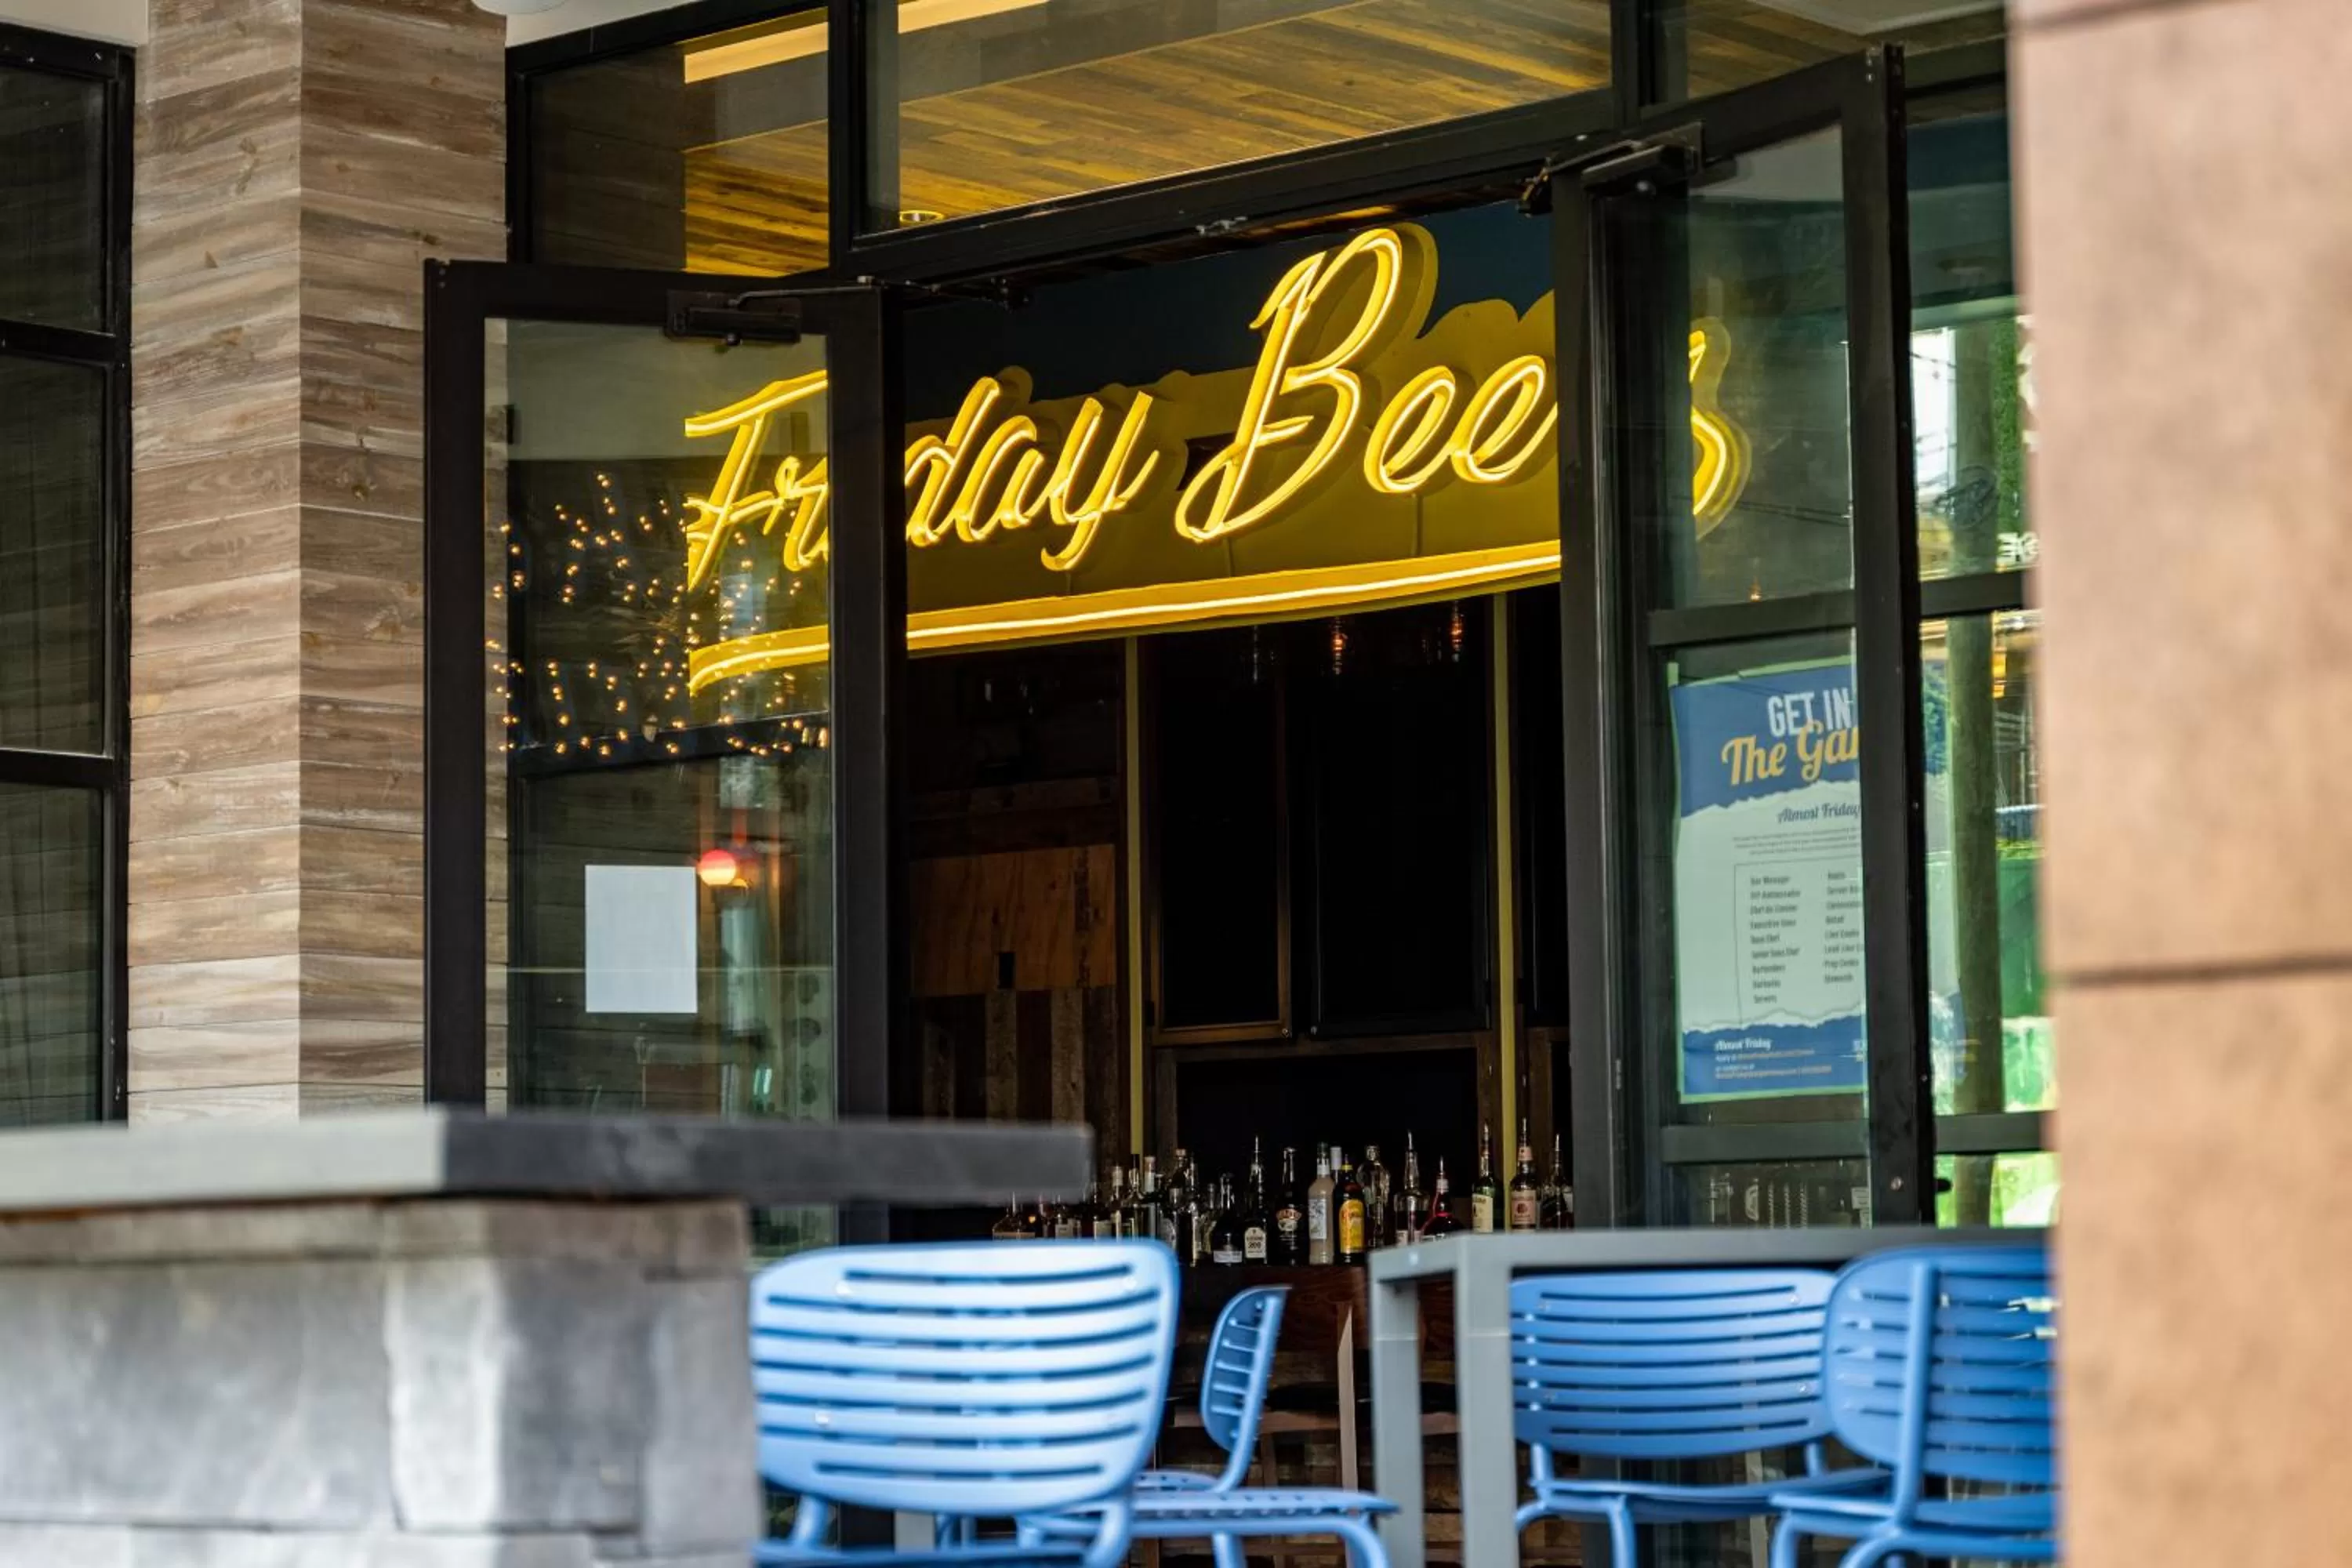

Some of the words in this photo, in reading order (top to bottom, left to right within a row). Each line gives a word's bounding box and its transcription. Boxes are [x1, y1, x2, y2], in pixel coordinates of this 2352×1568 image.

[684, 369, 1160, 591] Frday
[1174, 227, 1726, 544] Bee
[1767, 691, 1816, 738] GET
[1823, 687, 1853, 731] IN
[1721, 734, 1788, 786] The
